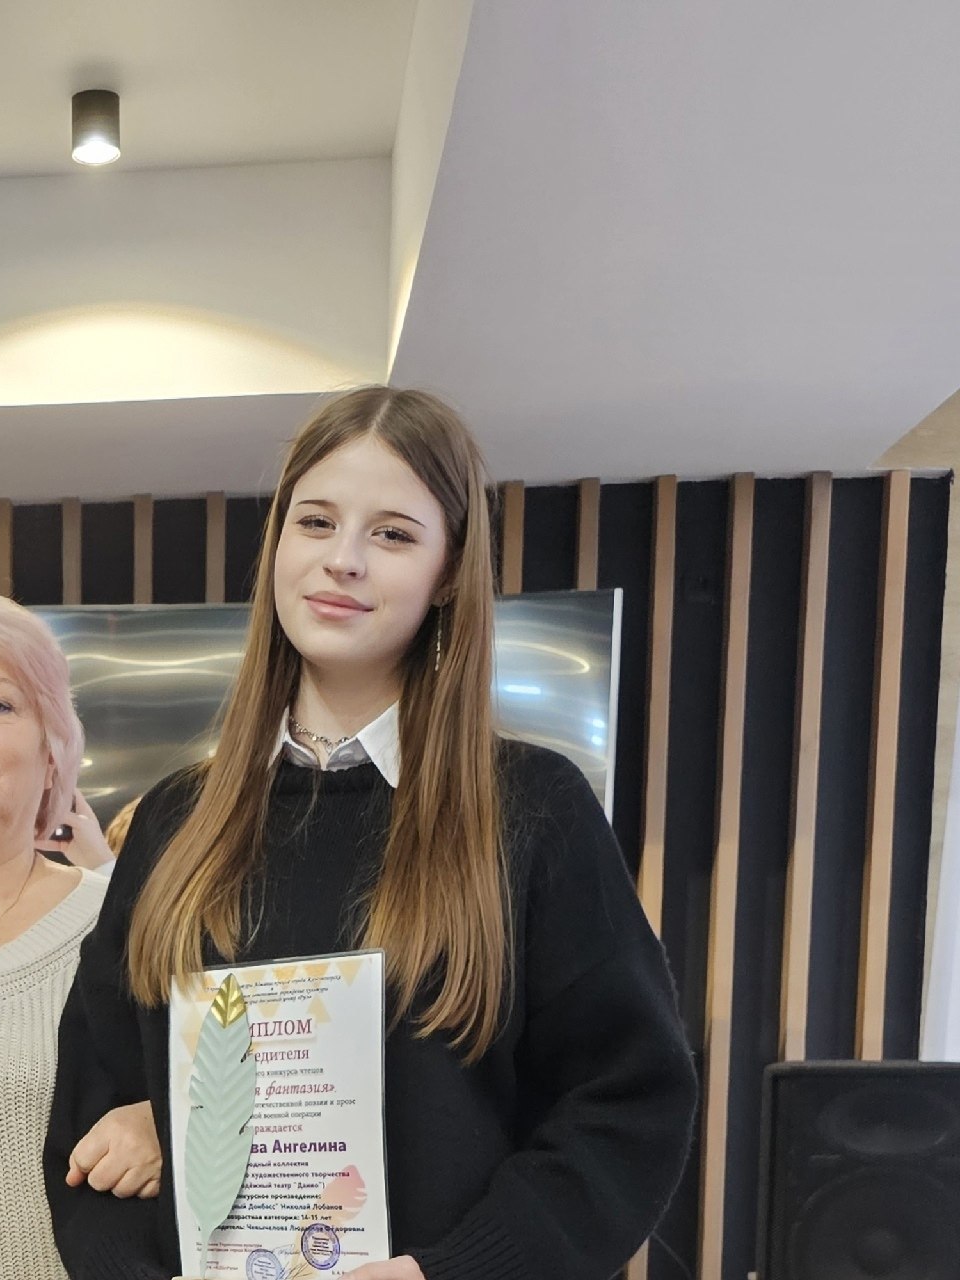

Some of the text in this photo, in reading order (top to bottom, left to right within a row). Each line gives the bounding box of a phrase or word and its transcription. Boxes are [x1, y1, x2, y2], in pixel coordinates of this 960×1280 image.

[248, 1018, 312, 1038] иплом
[254, 1049, 309, 1064] едителя
[254, 1124, 303, 1135] раждается
[272, 1139, 347, 1154] Ангелина
